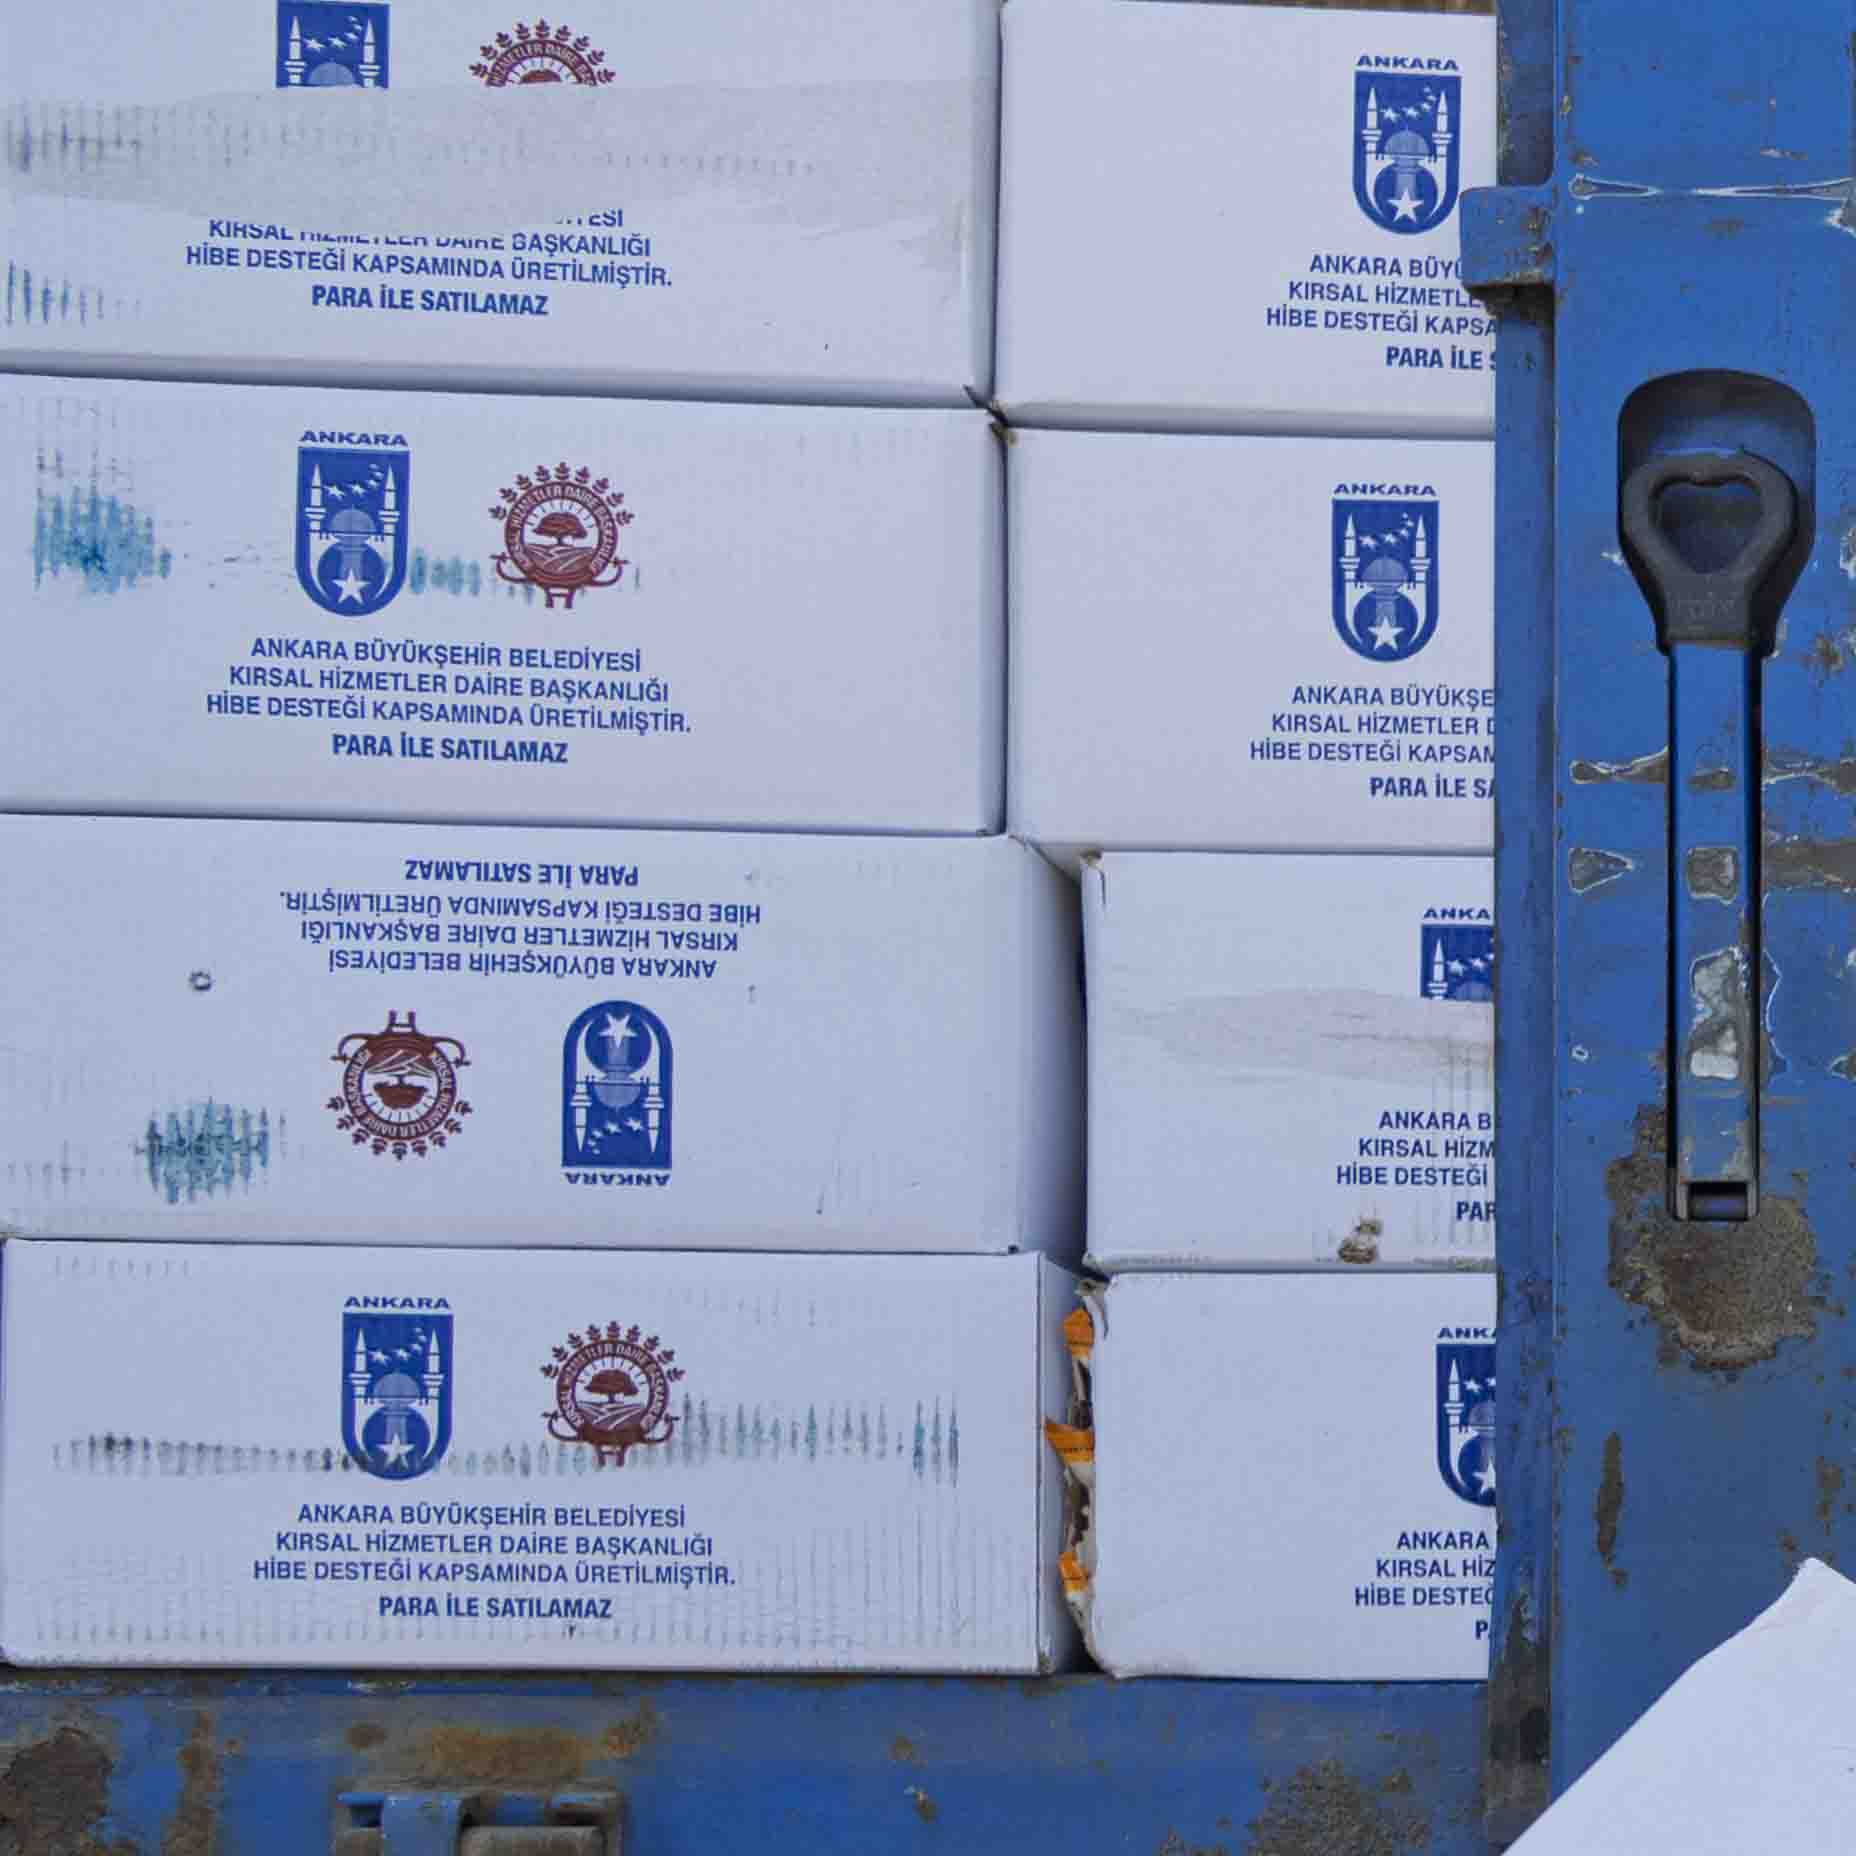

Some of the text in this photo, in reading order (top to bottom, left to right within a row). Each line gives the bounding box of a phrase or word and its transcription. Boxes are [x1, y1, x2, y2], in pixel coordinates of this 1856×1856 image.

[1356, 56, 1459, 72] ANKARA
[187, 242, 673, 291] HİBE DESTEĞİ KAPSAMINDA ÜRETİLMİŞTİR.
[1309, 255, 1402, 278] ANKARA
[312, 284, 548, 316] PARA İLE SATILAMAZ
[1288, 281, 1368, 303] KIRSAL
[1266, 304, 1418, 334] HİBE DESTEĞİ
[1386, 346, 1443, 368] PARA
[1450, 345, 1482, 370] İLE
[299, 431, 408, 448] ANKARA
[1333, 484, 1436, 497] ANKARA
[251, 638, 641, 673] ANKARA BÜYÜKŞEHİR BELEDİYESİ
[230, 665, 668, 704] KIRSAL HİZMETLER DAİRE BAŞKANLIĞI
[1292, 686, 1384, 707] ANKARA
[207, 690, 690, 737] HİBE DESTEĞİ KAPSAMINDA ÜRETİLMİŞTİR.
[1271, 711, 1479, 735] KIRSAL HİZMETLER
[332, 732, 568, 763] PARA İLE SATILAMAZ
[1250, 737, 1401, 763] HİBE DESTEĞİ
[1370, 774, 1466, 797] PARA İLE
[405, 859, 638, 888] PARA İLE SATILAMAZ
[279, 886, 760, 928] HİBE DESTEĞİ KAPSAMINDA ÜRETİLMİŞTİR.
[302, 918, 738, 952] KIRSAL HİZMETLER DAİRE BAŞKANLIĞI
[328, 948, 717, 979] ANKARA BÜYÜKŞEHİR BELEDİYESİ
[1379, 1111, 1470, 1132] ANKARA
[1358, 1138, 1438, 1158] KIRSAL
[563, 1169, 670, 1186] ANKARA
[1337, 1162, 1487, 1187] HİBE DESTEĞİ
[343, 1296, 450, 1311] ANKARA
[298, 1503, 685, 1529] ANKARA BÜYÜKŞEHİR BELEDİYESİ
[277, 1528, 712, 1560] KIRSAL HİZMETLER DAİRE BAŞKANLIĞI
[1396, 1531, 1488, 1551] ANKARA
[254, 1556, 735, 1590] HİBE DESTEĞİ KAPSAMINDA ÜRETİLMİŞTİR.
[1376, 1559, 1456, 1578] KIRSAL
[379, 1593, 611, 1619] PARA İLE SATILAMAZ
[1355, 1583, 1405, 1606] HİBE
